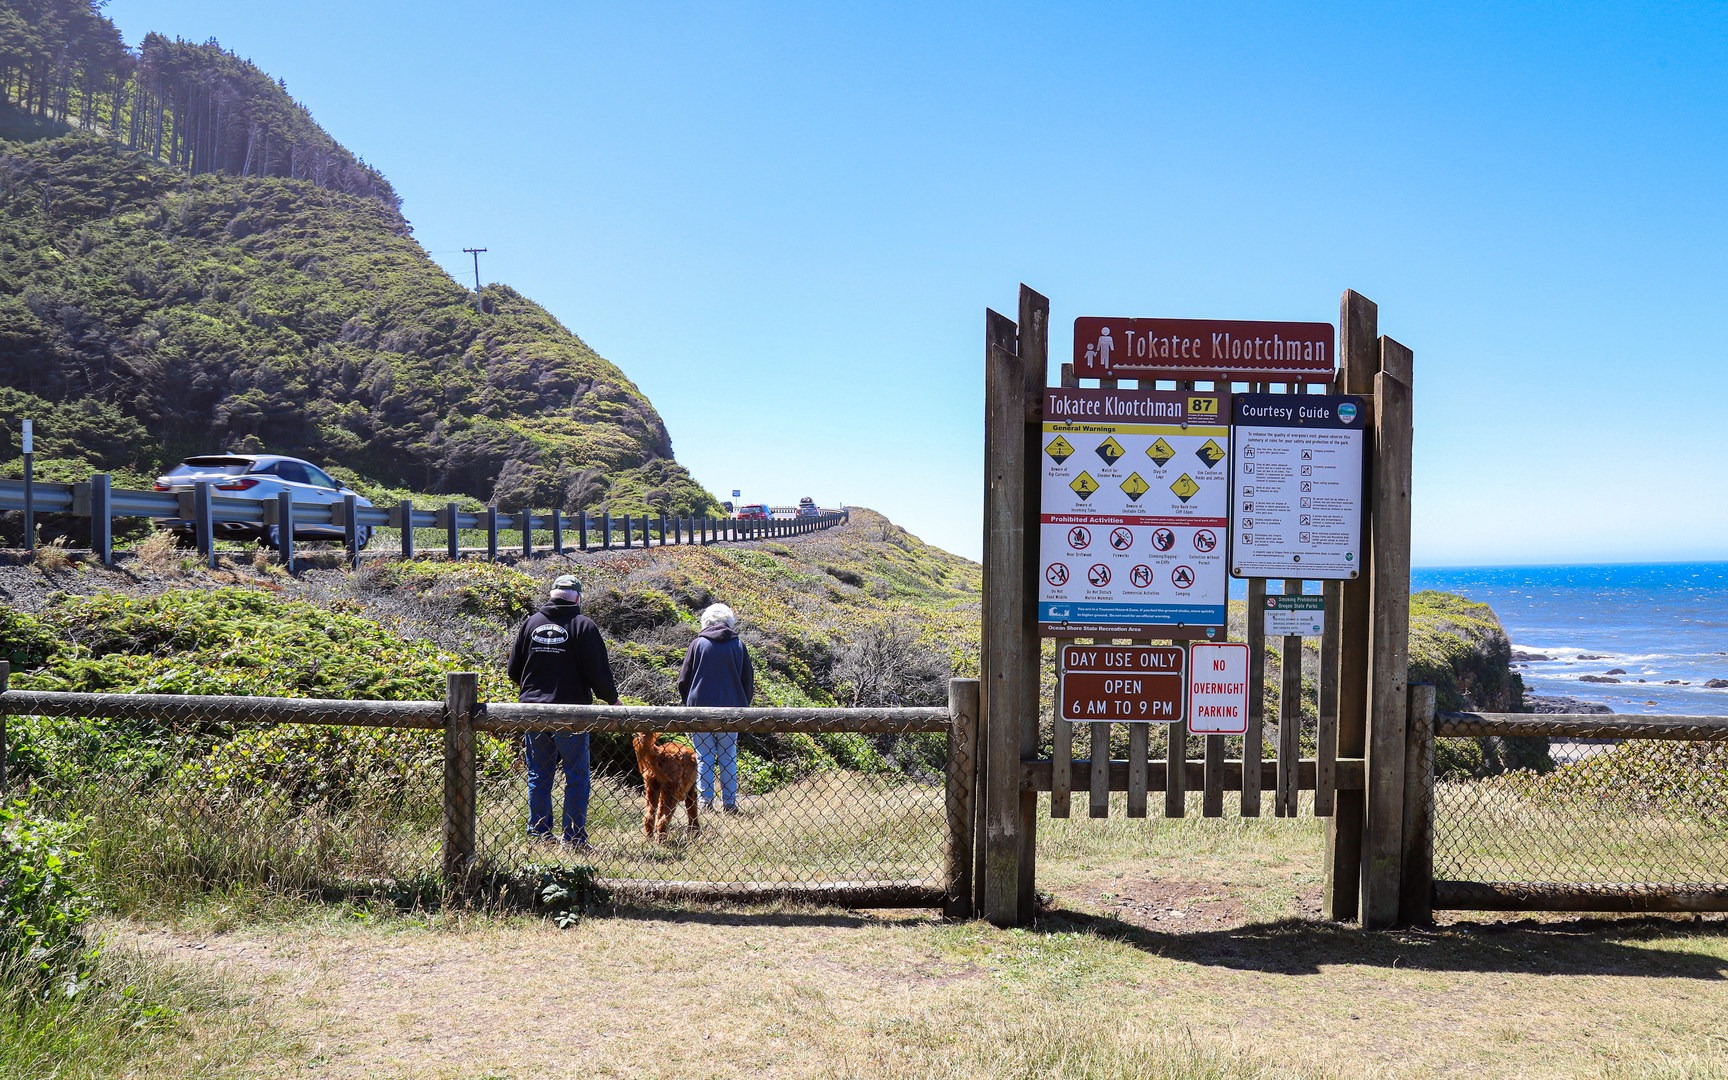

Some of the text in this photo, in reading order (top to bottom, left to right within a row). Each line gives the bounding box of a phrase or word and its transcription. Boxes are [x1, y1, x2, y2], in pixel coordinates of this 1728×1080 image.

[1124, 330, 1326, 362] Tokatee Klootchman
[1049, 394, 1182, 418] Tokatee Klootchman
[1192, 399, 1212, 412] 87
[1242, 404, 1330, 420] Courtesy Guide
[1070, 652, 1177, 668] DAY USE ONLY
[1213, 659, 1226, 671] NO
[1104, 679, 1142, 694] OPEN
[1193, 683, 1245, 695] OVERNIGHT
[1072, 700, 1173, 715] 6 AM TO 9 PM
[1198, 705, 1238, 718] PARKING
